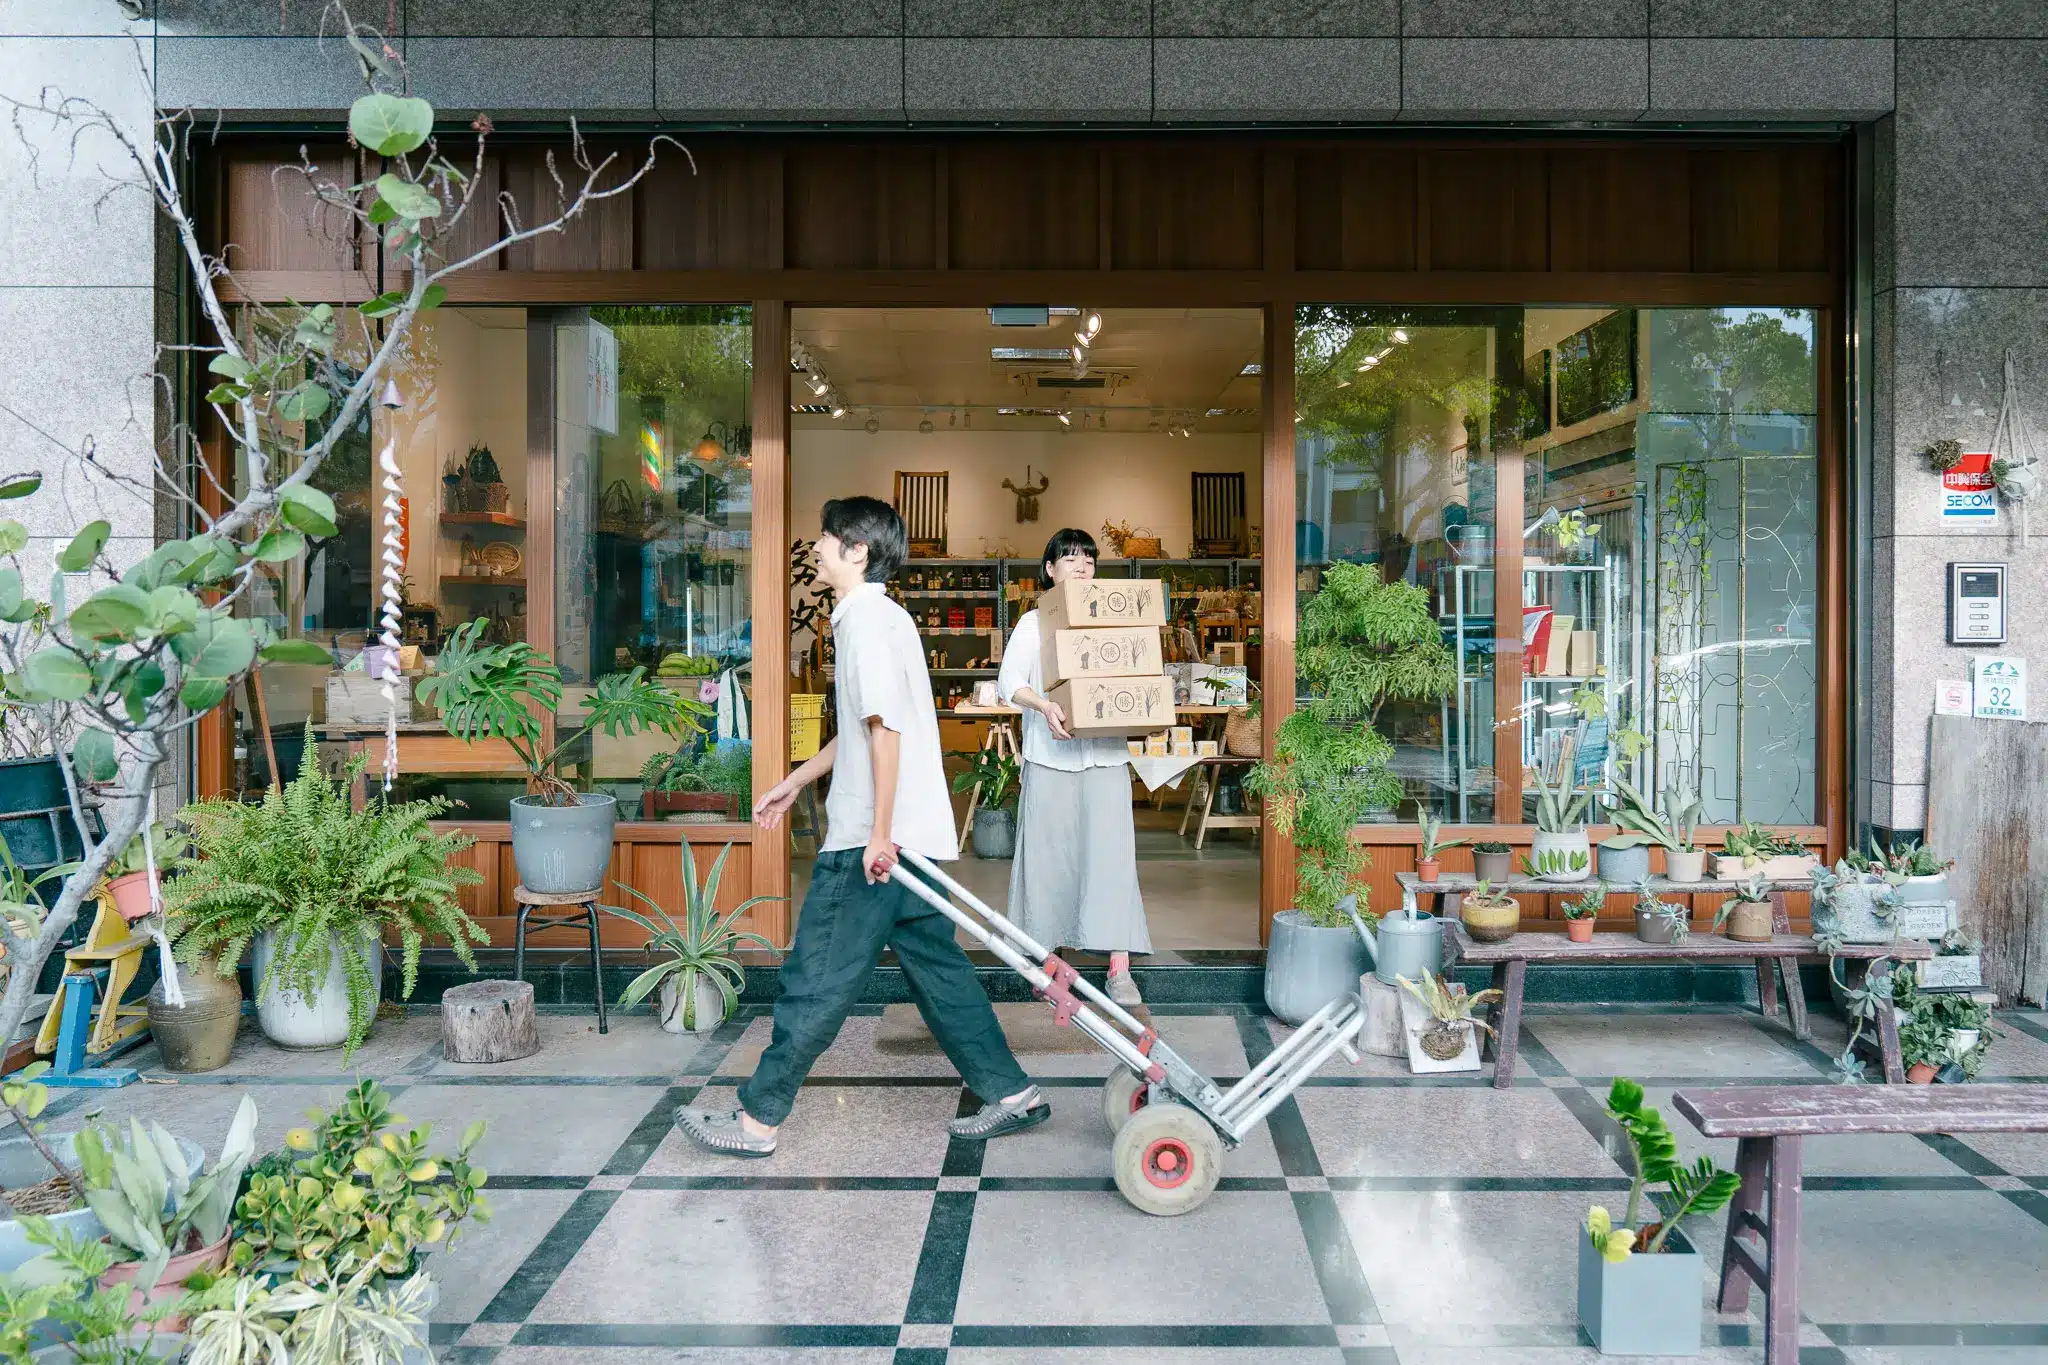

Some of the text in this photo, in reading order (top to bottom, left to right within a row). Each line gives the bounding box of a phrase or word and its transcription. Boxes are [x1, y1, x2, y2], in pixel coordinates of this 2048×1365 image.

[1946, 472, 1992, 486] 中興保全
[1946, 494, 1992, 507] SECOM
[1989, 686, 2011, 706] 32
